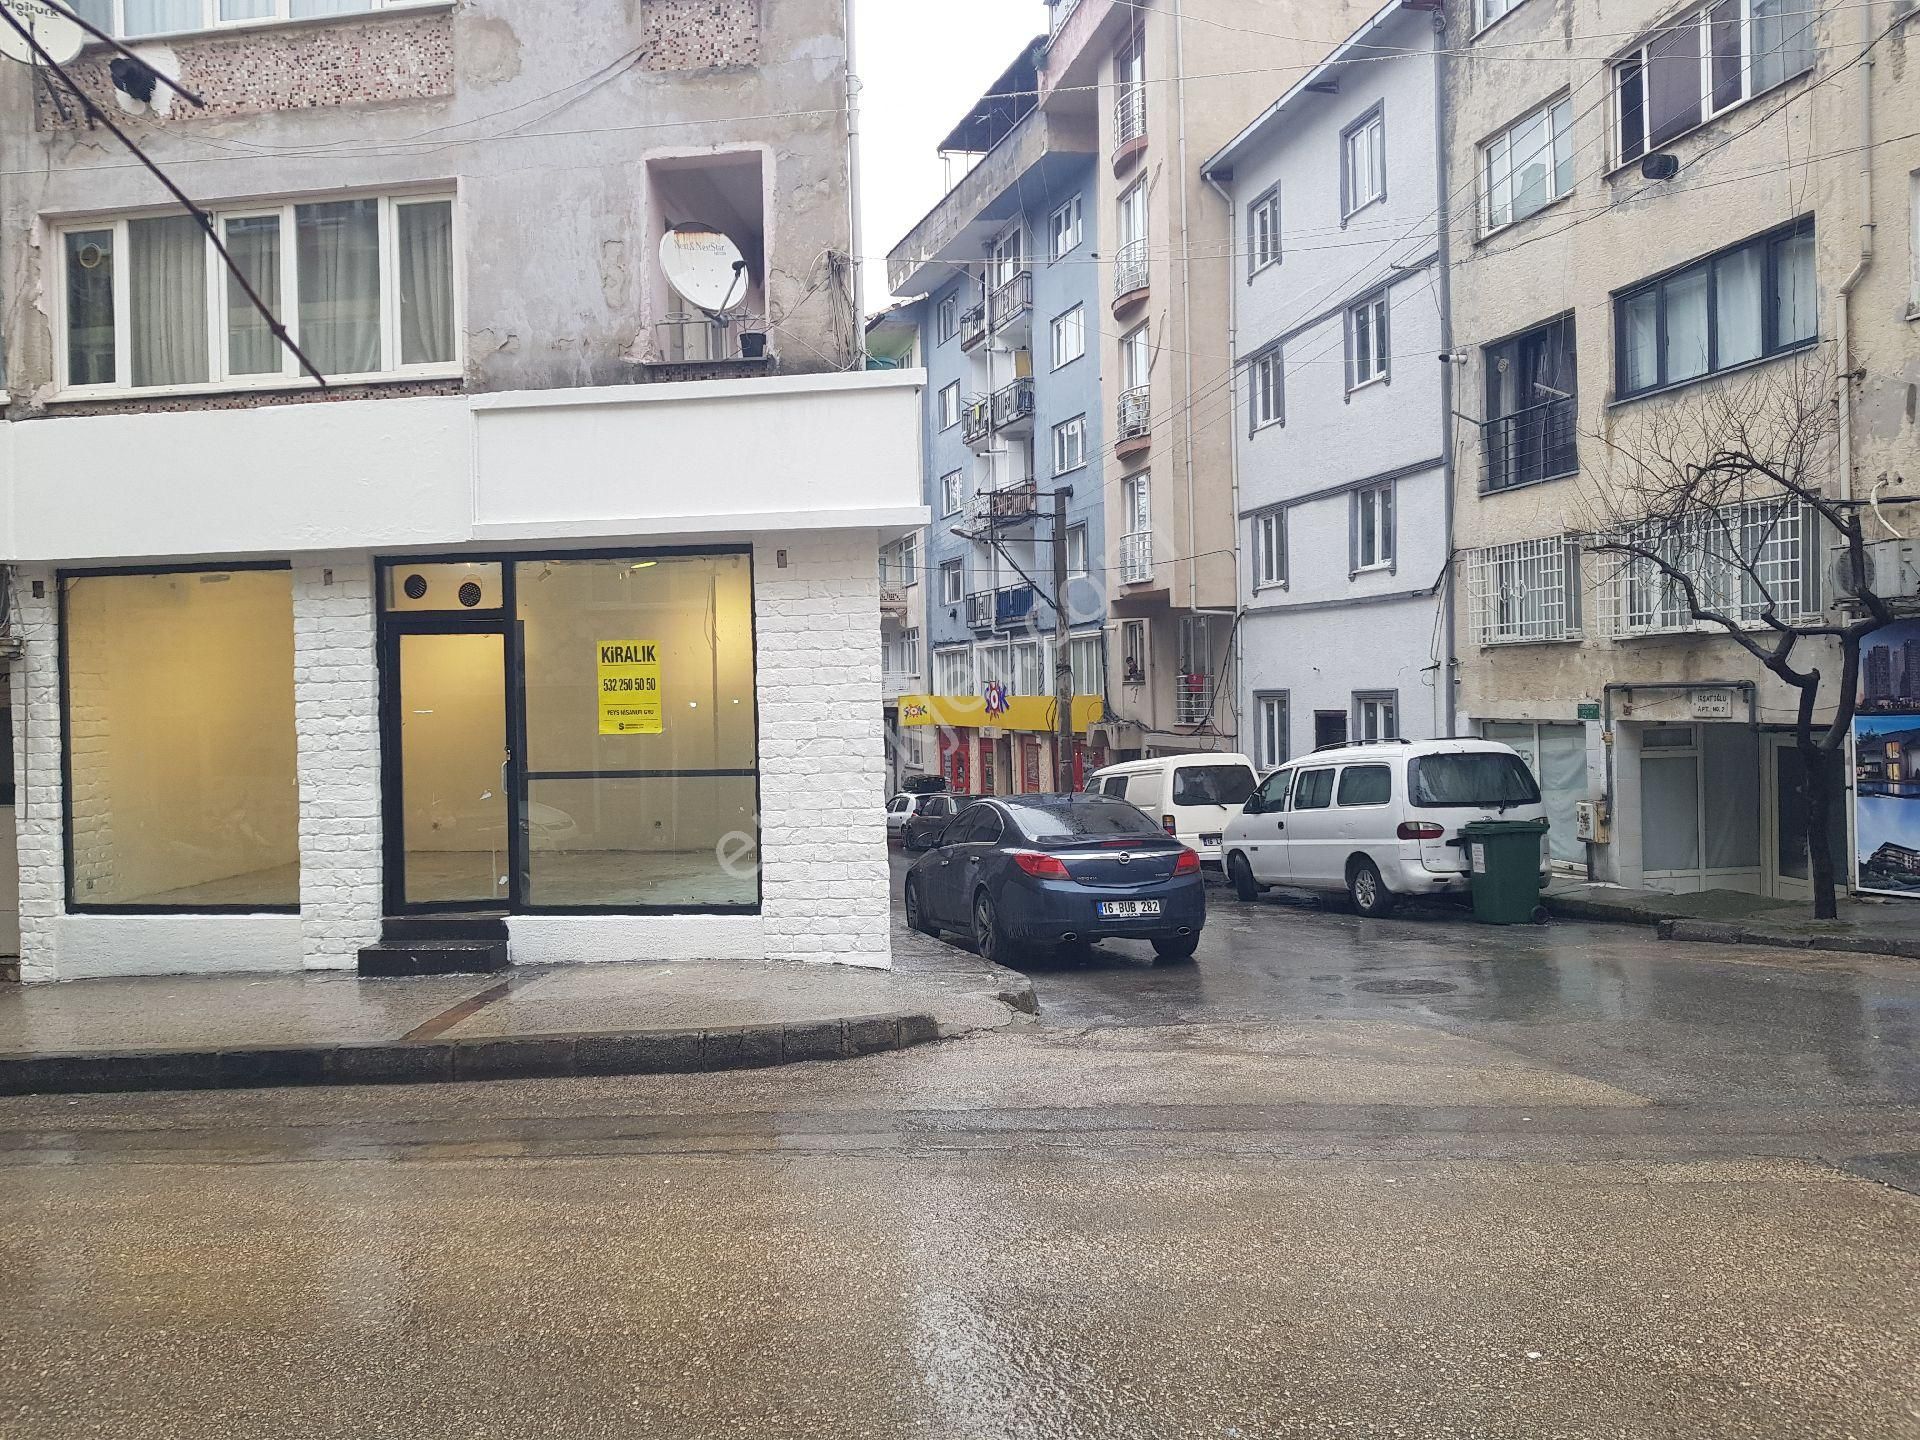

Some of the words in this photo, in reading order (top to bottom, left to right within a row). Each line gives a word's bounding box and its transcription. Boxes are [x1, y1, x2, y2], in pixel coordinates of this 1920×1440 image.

[603, 678, 617, 691] 532
[619, 678, 632, 691] 250
[635, 677, 644, 690] 50
[646, 677, 656, 690] 50
[1103, 902, 1114, 914] 16
[1118, 902, 1136, 912] BUB
[1141, 901, 1158, 912] 282
